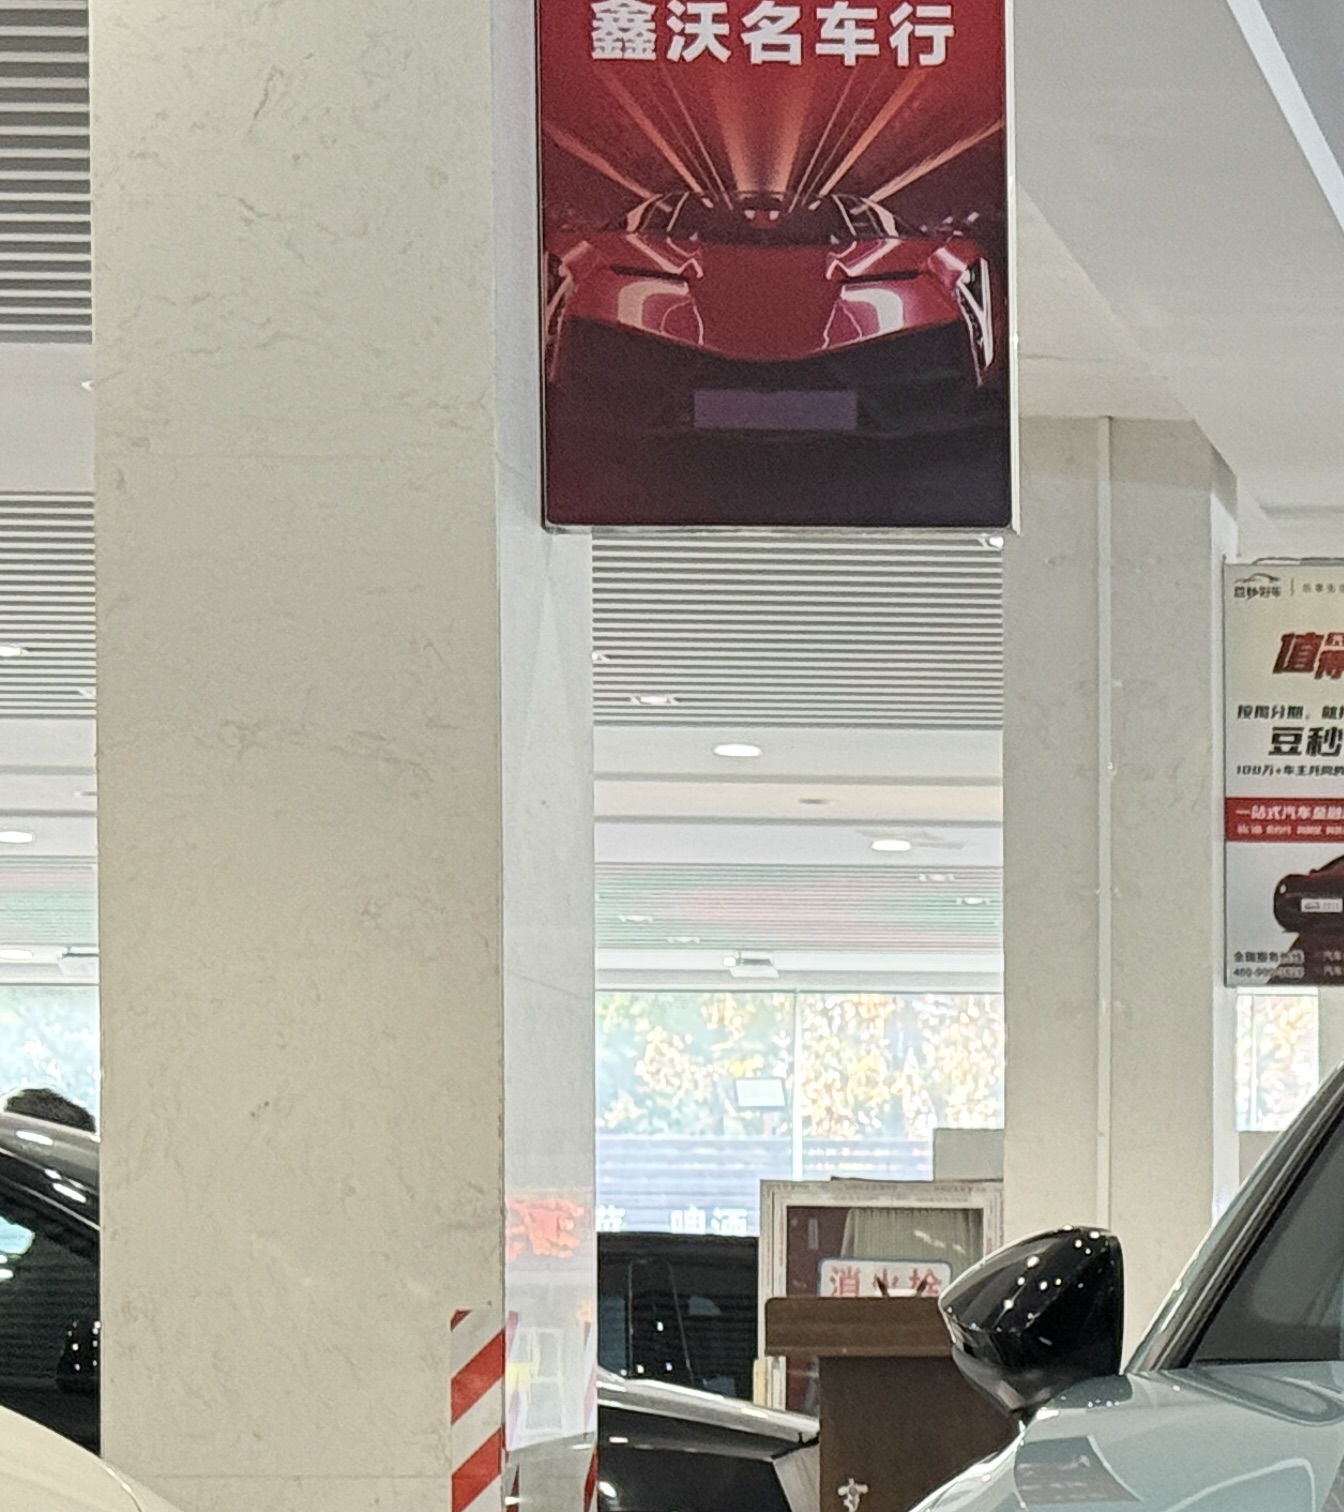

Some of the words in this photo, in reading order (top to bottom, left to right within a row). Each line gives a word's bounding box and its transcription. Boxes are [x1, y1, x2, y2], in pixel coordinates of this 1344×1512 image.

[591, 0, 955, 66] 鑫沃名车行
